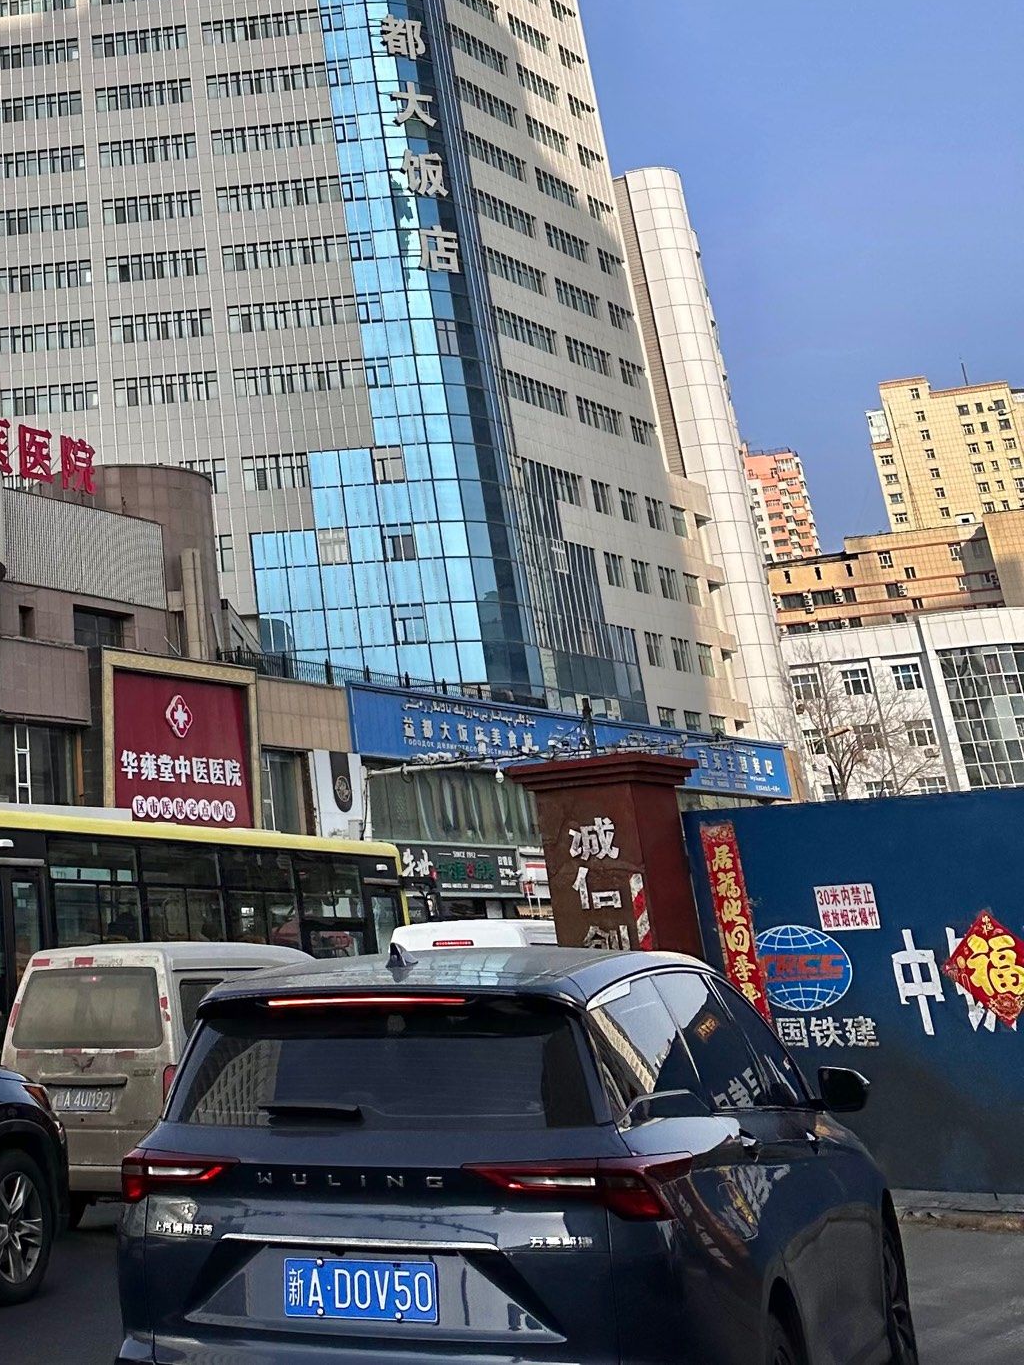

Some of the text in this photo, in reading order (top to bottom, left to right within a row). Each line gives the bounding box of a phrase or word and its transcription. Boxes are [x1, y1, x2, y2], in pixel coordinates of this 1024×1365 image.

[403, 716, 533, 749] 益都大饭店美食城
[121, 749, 242, 786] 华雍堂中医医院
[698, 749, 775, 777] 音乐主题餐吧
[134, 796, 236, 821] 区市医保定点单位
[816, 886, 874, 906] 30米内禁止
[821, 907, 879, 929] 燃放烟花爆竹
[966, 933, 1024, 997] 福
[257, 1171, 444, 1189] WULING
[155, 1221, 214, 1236] 上汽通用五菱
